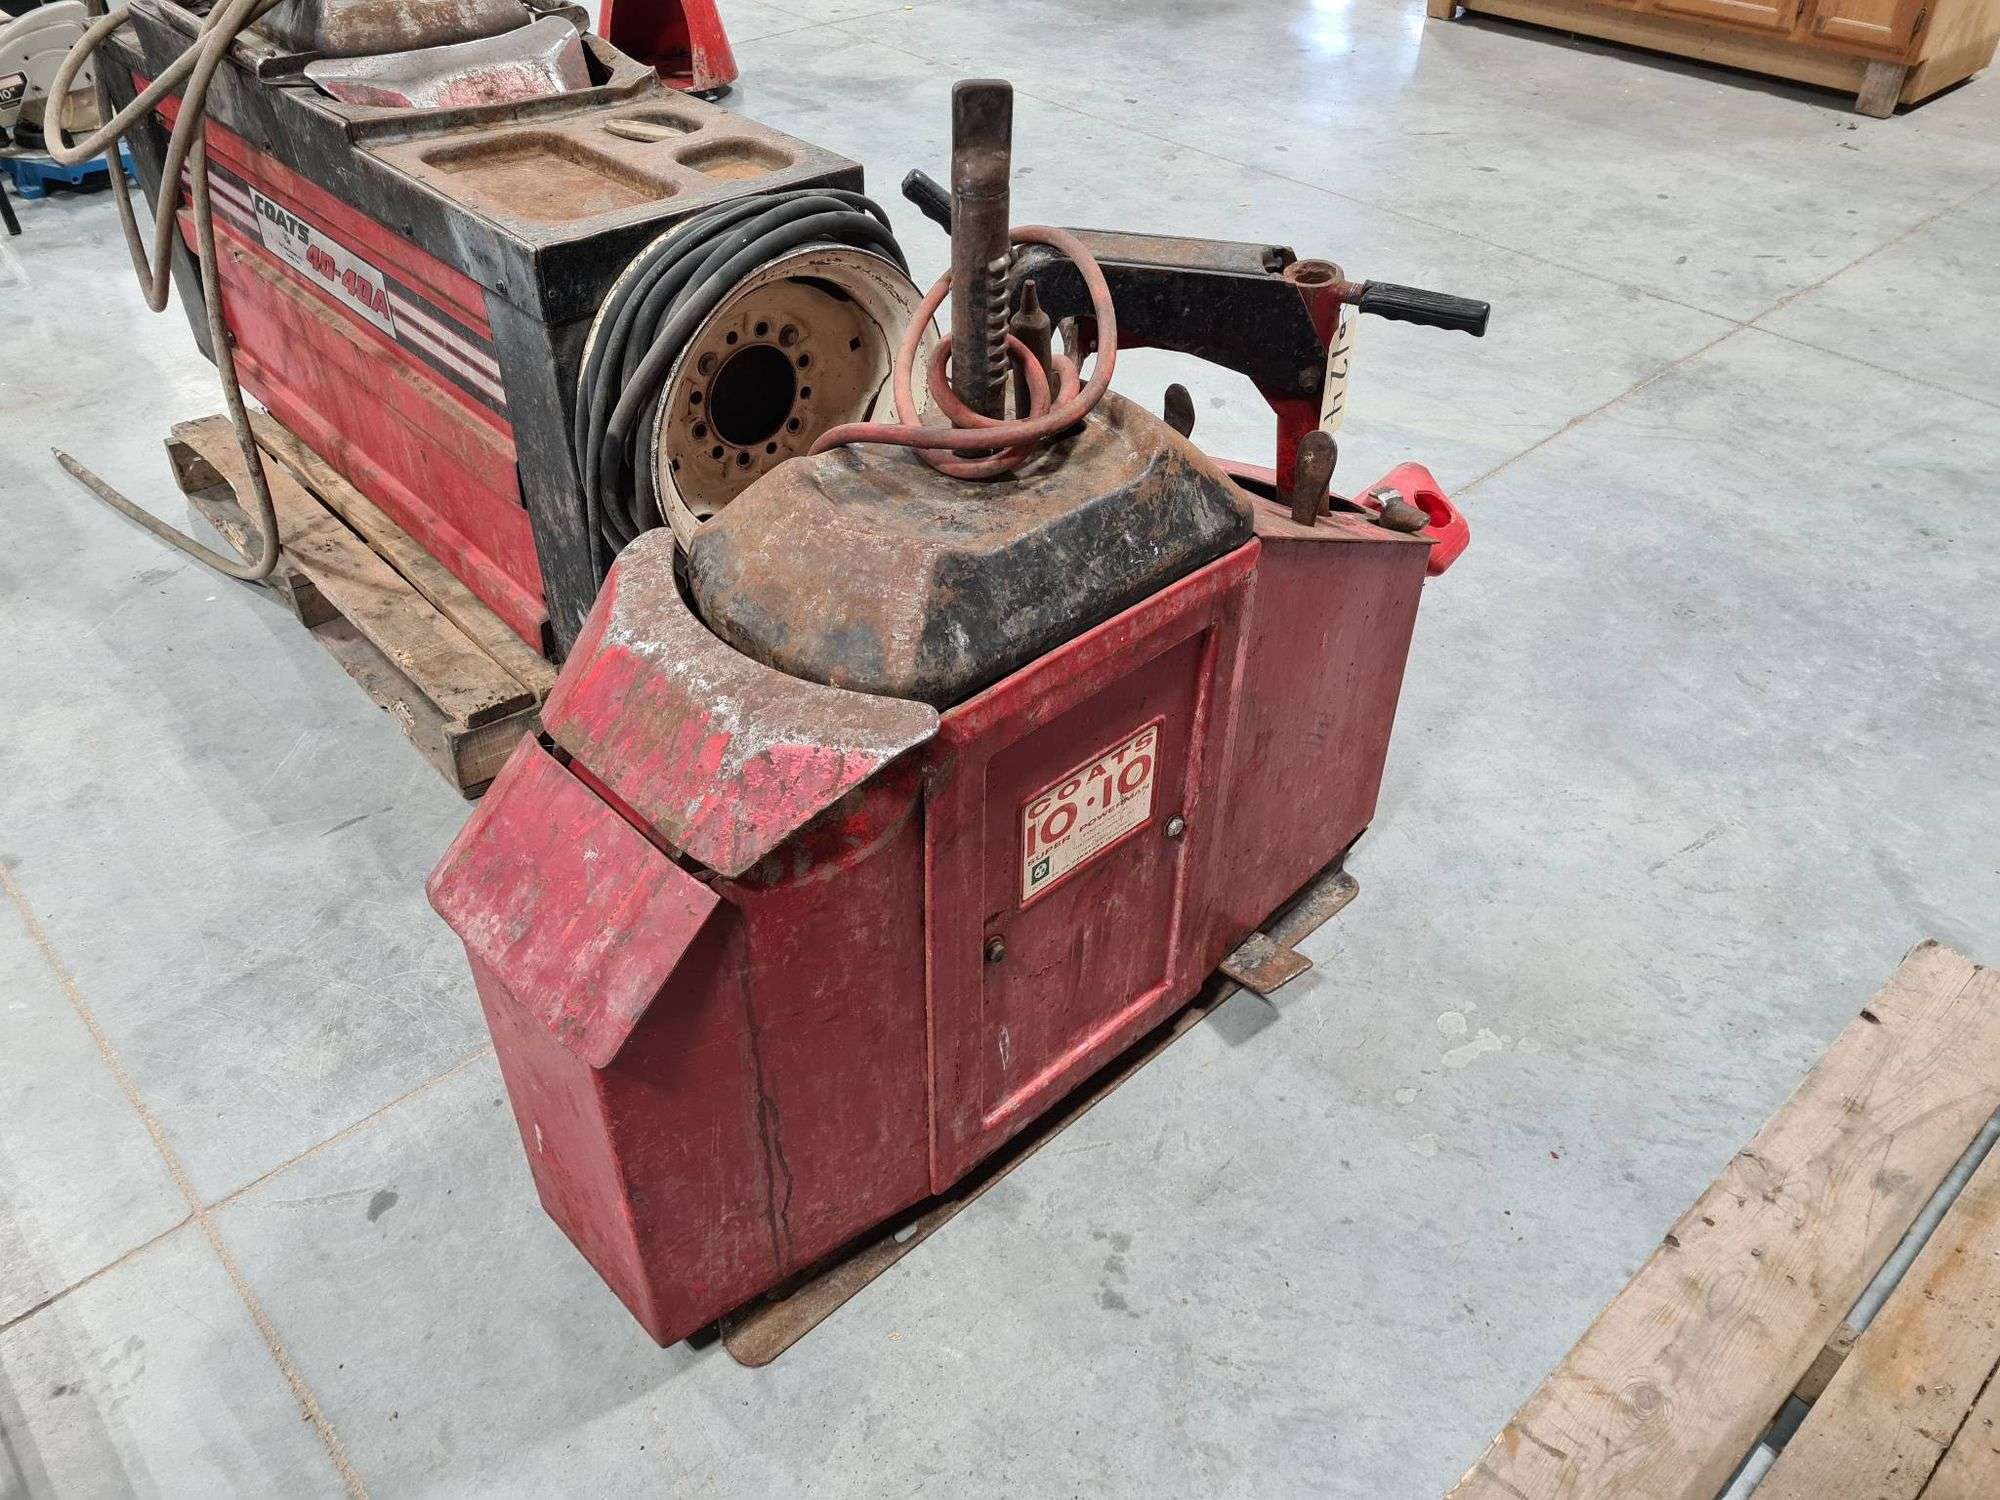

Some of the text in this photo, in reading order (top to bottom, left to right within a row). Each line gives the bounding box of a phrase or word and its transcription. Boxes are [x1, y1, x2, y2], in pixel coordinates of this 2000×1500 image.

[255, 194, 310, 245] COATS
[306, 244, 390, 321] 40-40A
[1028, 732, 1153, 819] COATS
[1027, 834, 1071, 867] SUPER
[1079, 783, 1150, 833] POWERMAN
